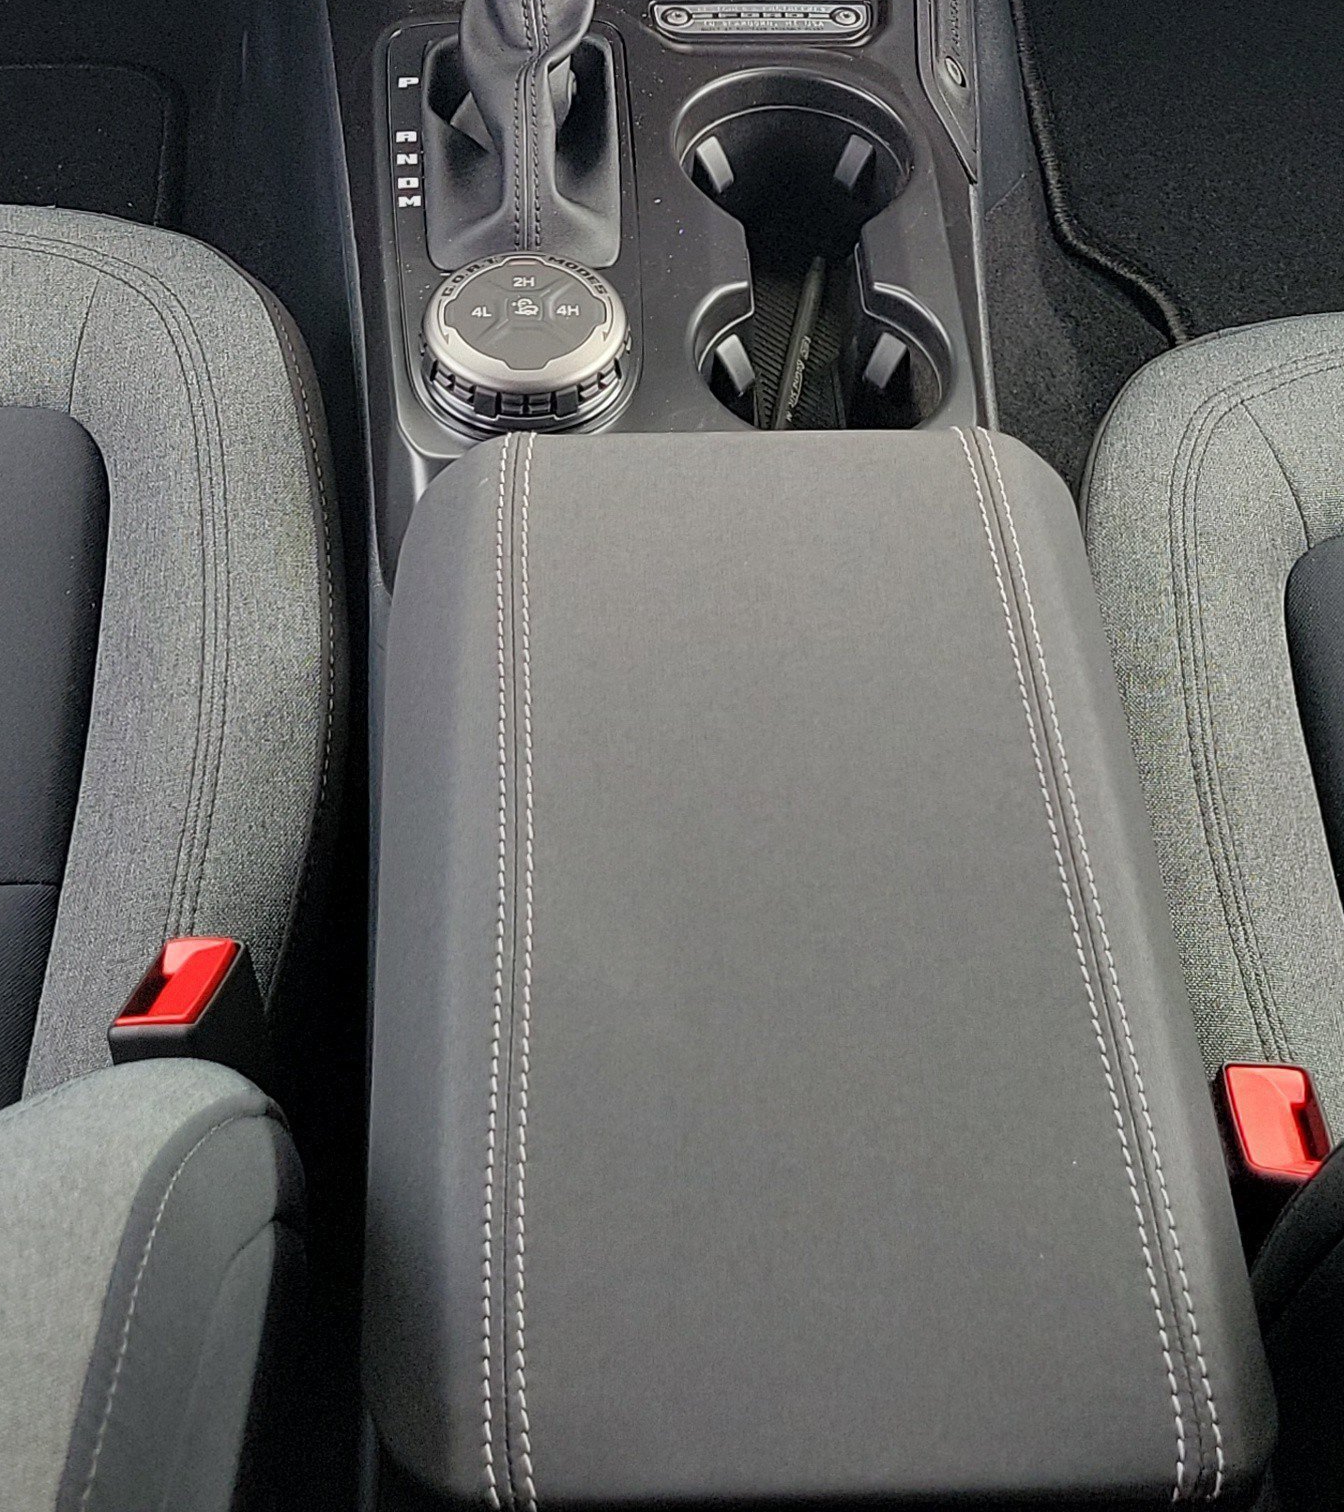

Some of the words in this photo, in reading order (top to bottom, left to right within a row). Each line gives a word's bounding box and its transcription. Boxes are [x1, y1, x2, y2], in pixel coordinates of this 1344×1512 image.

[398, 76, 420, 88] P
[396, 153, 418, 165] N
[397, 177, 419, 189] D
[398, 195, 422, 208] M
[547, 256, 608, 295] MODES
[513, 277, 535, 287] 2H
[471, 306, 492, 317] 4L
[556, 305, 580, 316] 4H
